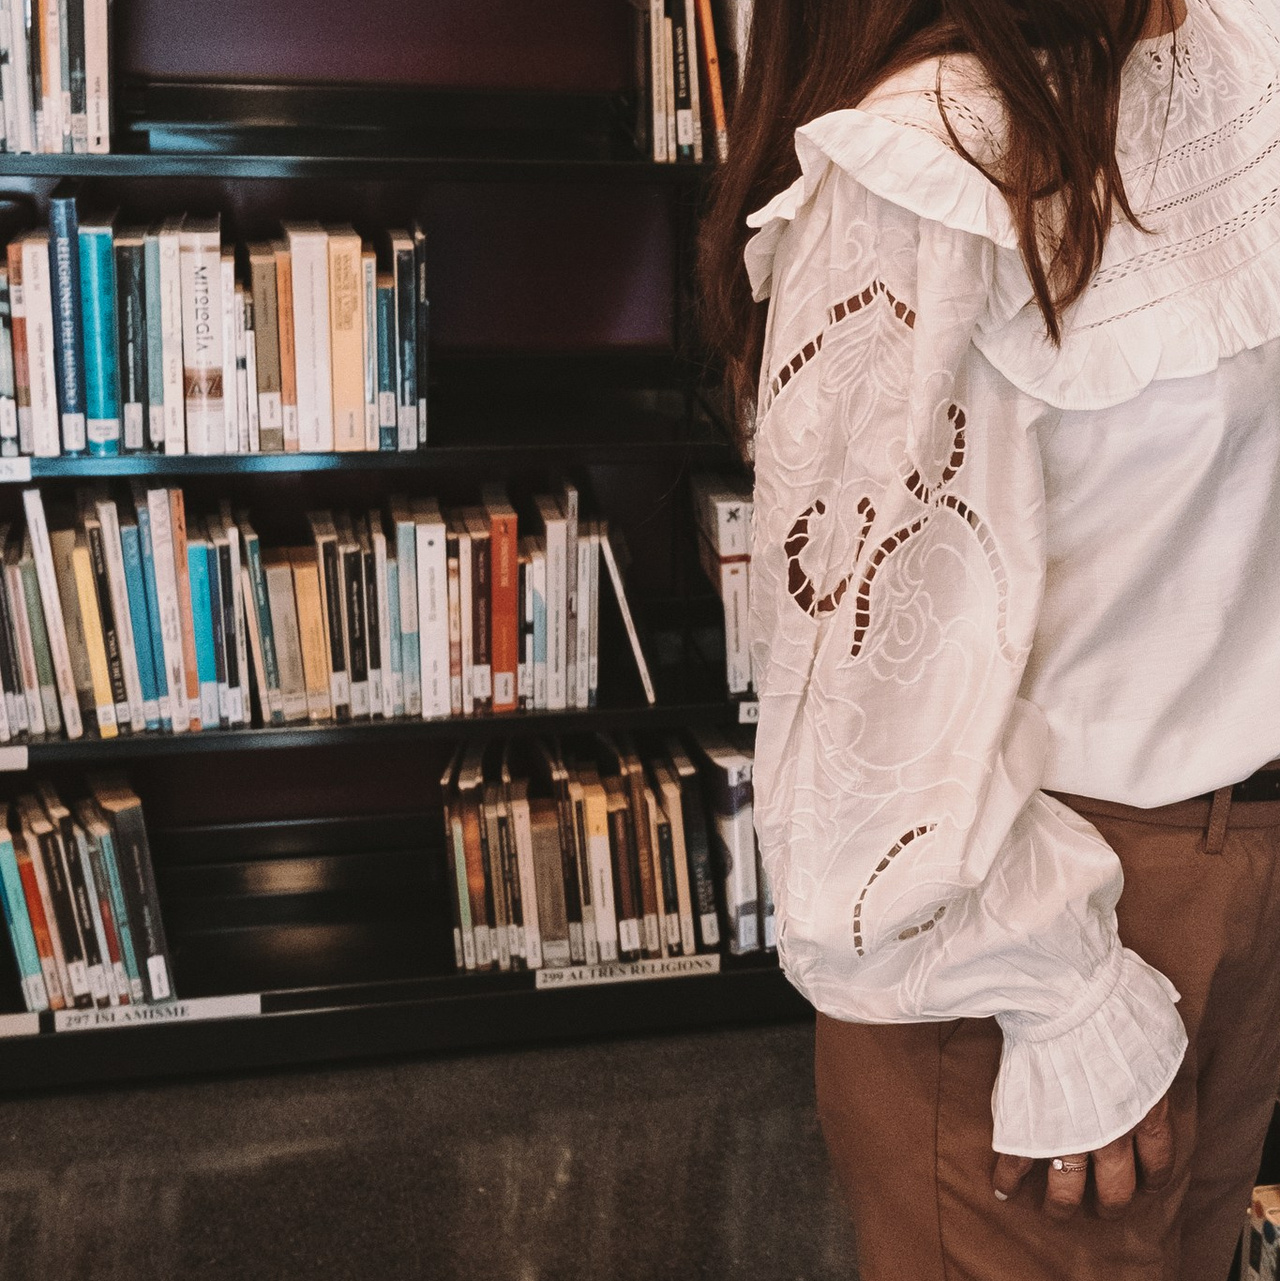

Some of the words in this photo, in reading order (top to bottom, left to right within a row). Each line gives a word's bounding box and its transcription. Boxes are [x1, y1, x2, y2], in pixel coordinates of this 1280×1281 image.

[192, 265, 214, 353] MITOLOGÍA
[630, 956, 715, 978] RELIGIONS
[65, 1012, 88, 1026] 297
